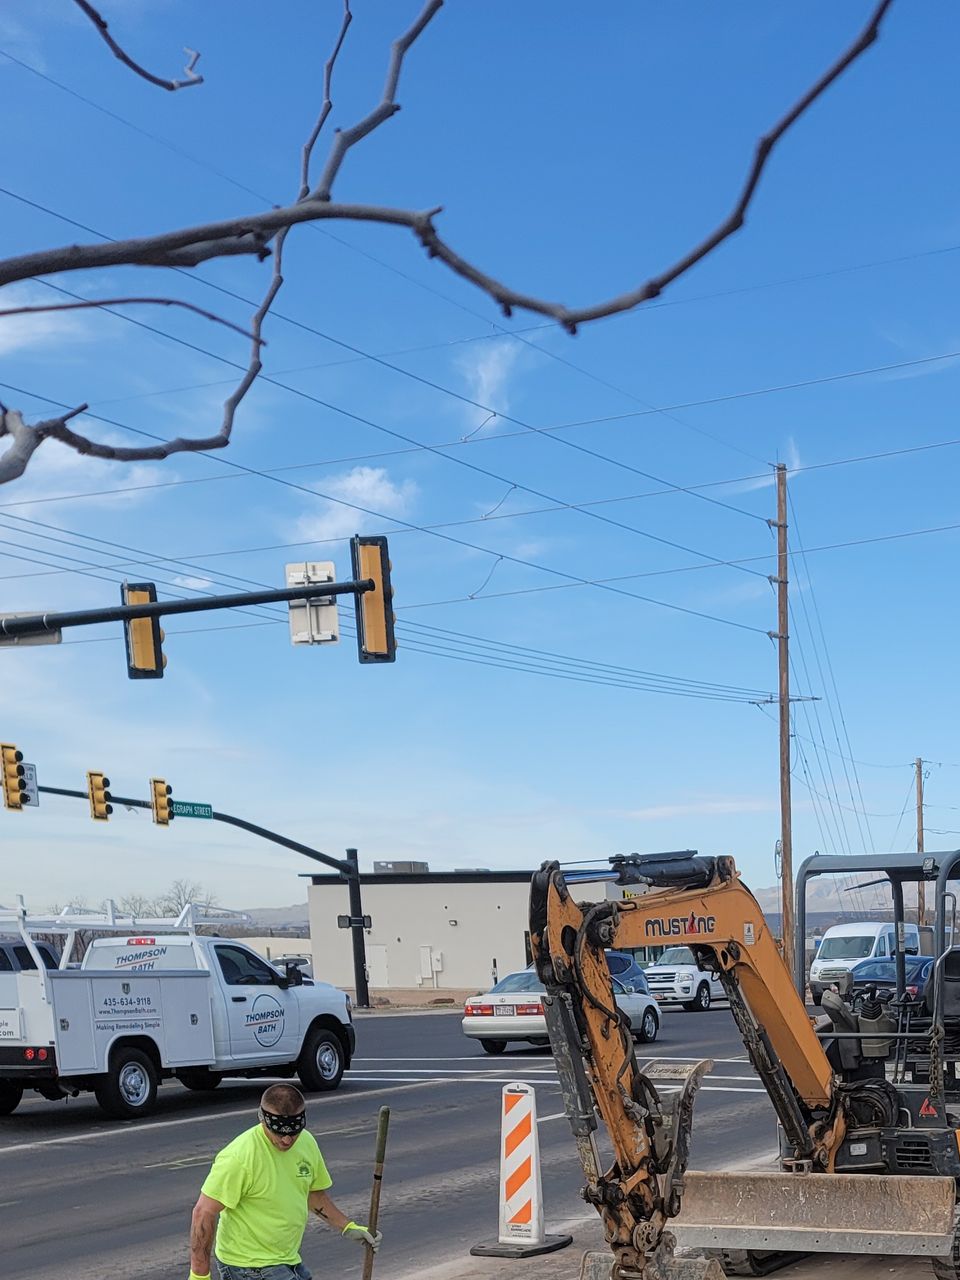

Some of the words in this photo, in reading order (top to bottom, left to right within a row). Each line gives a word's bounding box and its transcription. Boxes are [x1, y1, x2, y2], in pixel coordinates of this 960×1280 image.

[194, 806, 211, 816] STREET
[116, 946, 168, 965] THOMPSON
[103, 997, 152, 1006] 435-634-9118
[245, 1008, 285, 1023] THOMPSON
[257, 1023, 277, 1034] BATH
